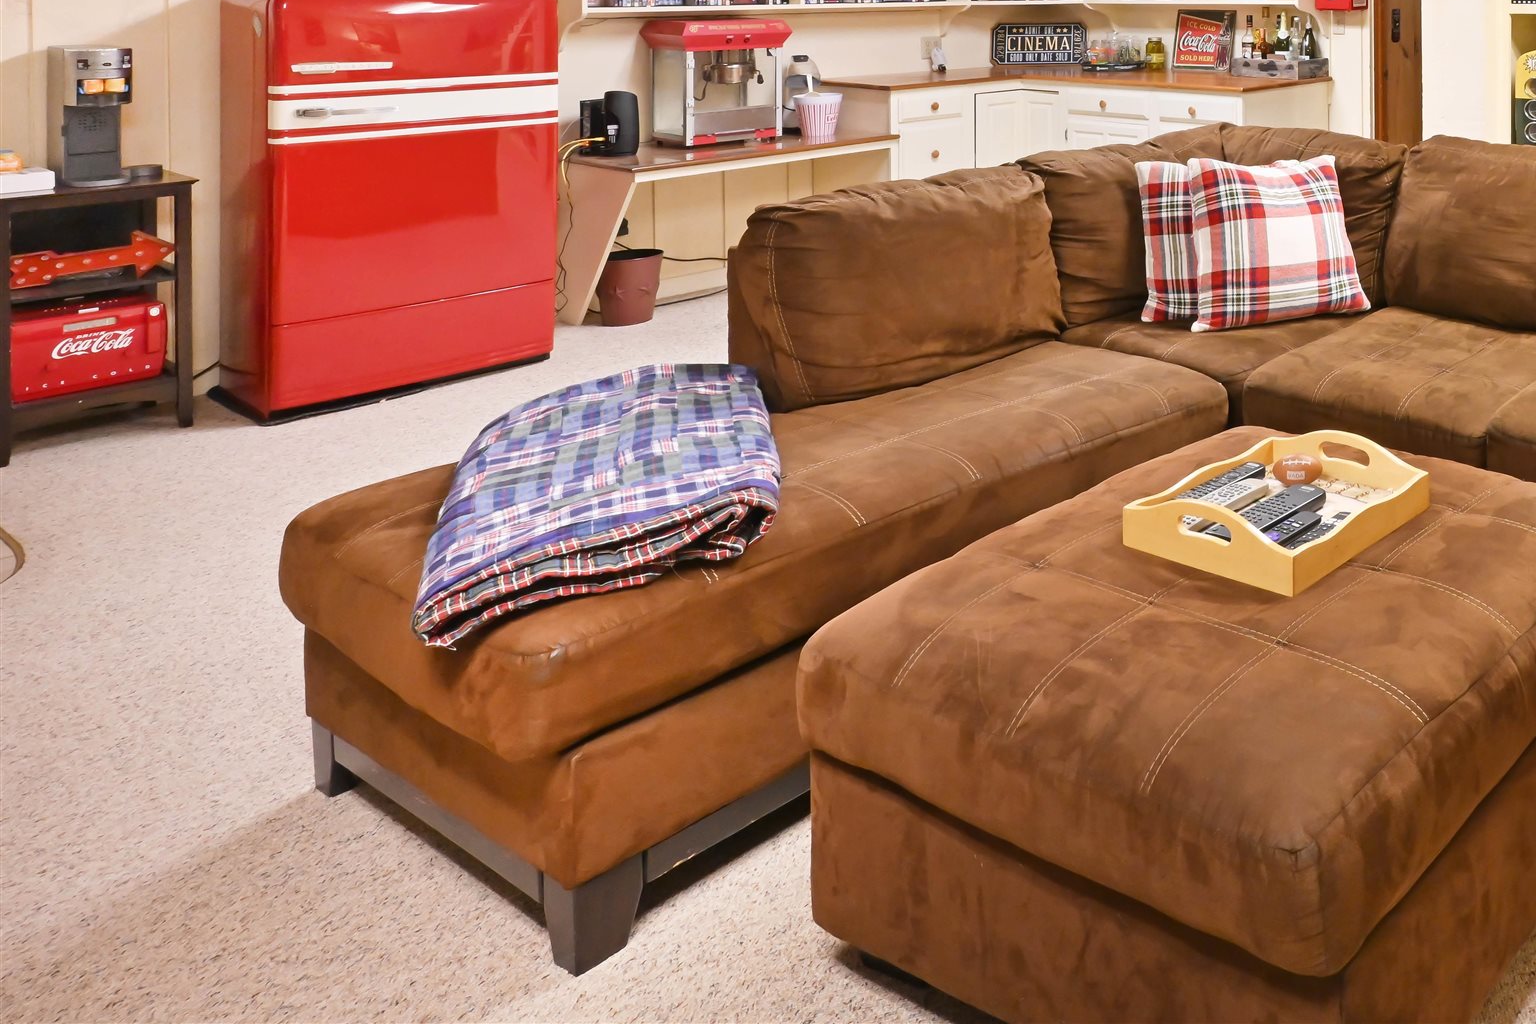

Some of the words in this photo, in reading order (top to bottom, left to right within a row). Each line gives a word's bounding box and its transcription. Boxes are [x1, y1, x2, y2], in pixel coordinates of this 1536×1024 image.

[1025, 26, 1041, 35] ADMIT
[1044, 26, 1054, 35] ONE
[1187, 21, 1198, 29] ICE
[1200, 23, 1216, 32] COLD
[1008, 36, 1070, 51] CINEMA
[1180, 31, 1217, 53] Coca-Cola
[1010, 53, 1023, 62] GOOD
[1025, 53, 1038, 62] ONLY
[1041, 52, 1053, 62] DATE
[1056, 52, 1068, 61] SOLD
[1180, 54, 1198, 62] SOLD
[76, 330, 105, 340] DRINK
[51, 328, 136, 360] Coca-Cola
[93, 364, 151, 379] COLD
[25, 379, 65, 392] ICE
